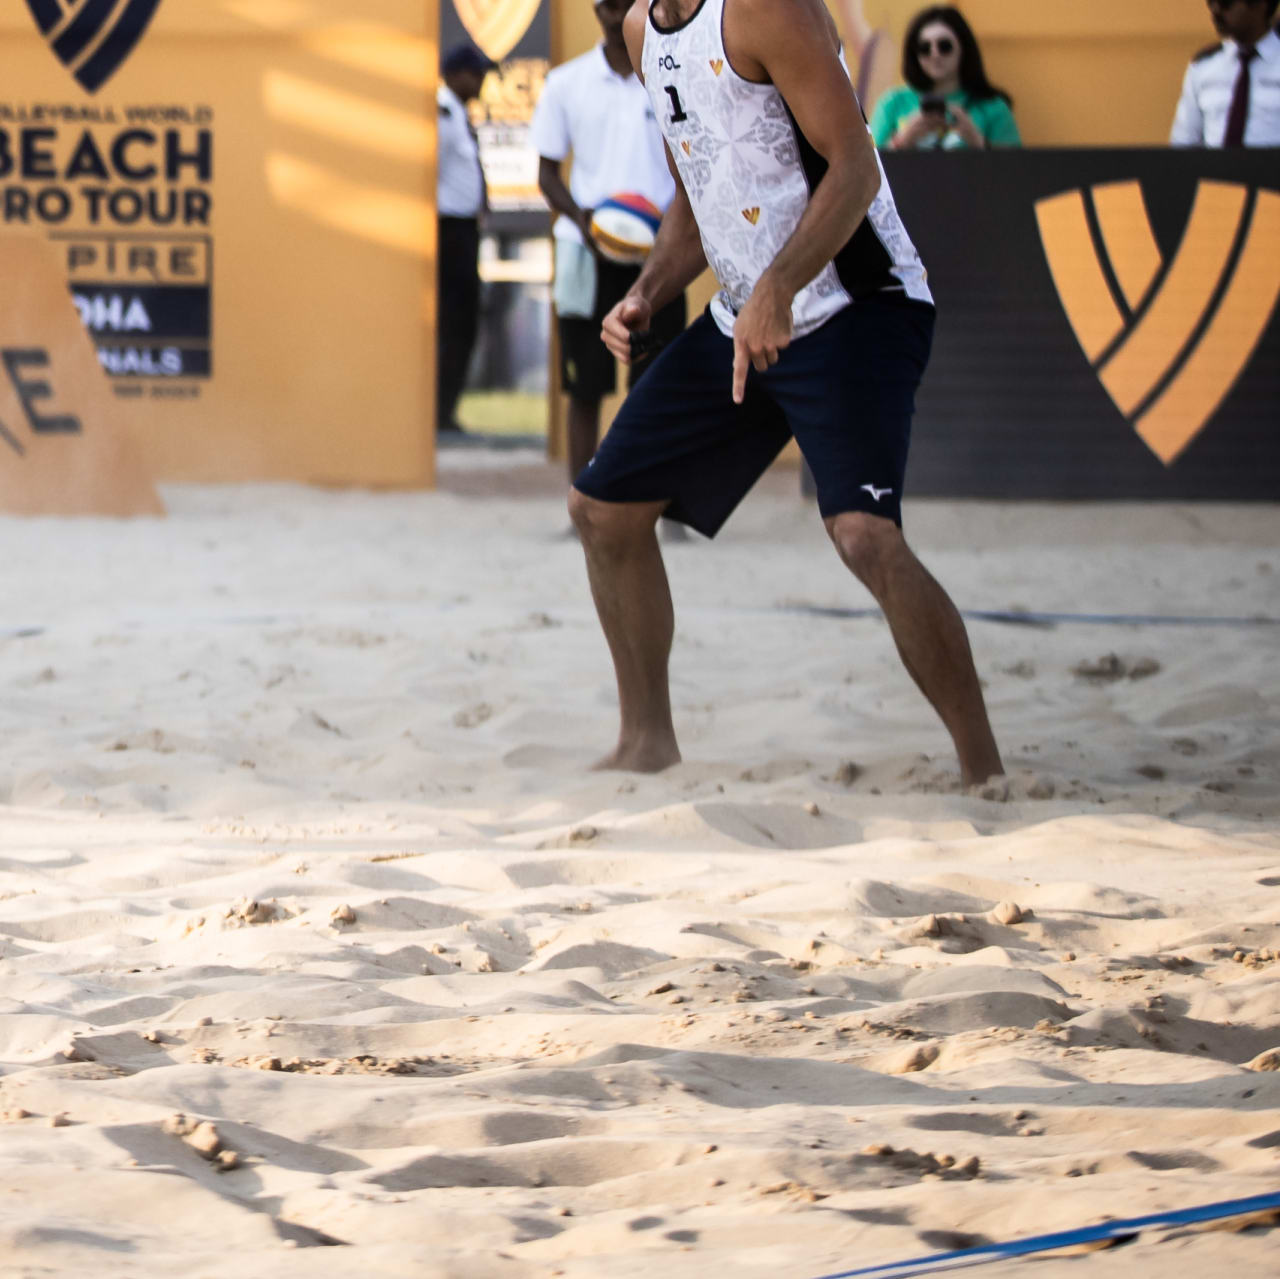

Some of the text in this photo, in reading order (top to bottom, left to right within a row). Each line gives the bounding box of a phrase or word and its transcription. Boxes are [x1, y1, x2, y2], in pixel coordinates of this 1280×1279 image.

[658, 54, 681, 72] POL
[124, 103, 213, 124] WORLD
[664, 84, 688, 124] 1
[81, 187, 212, 227] TOUR
[67, 240, 197, 282] PIRE
